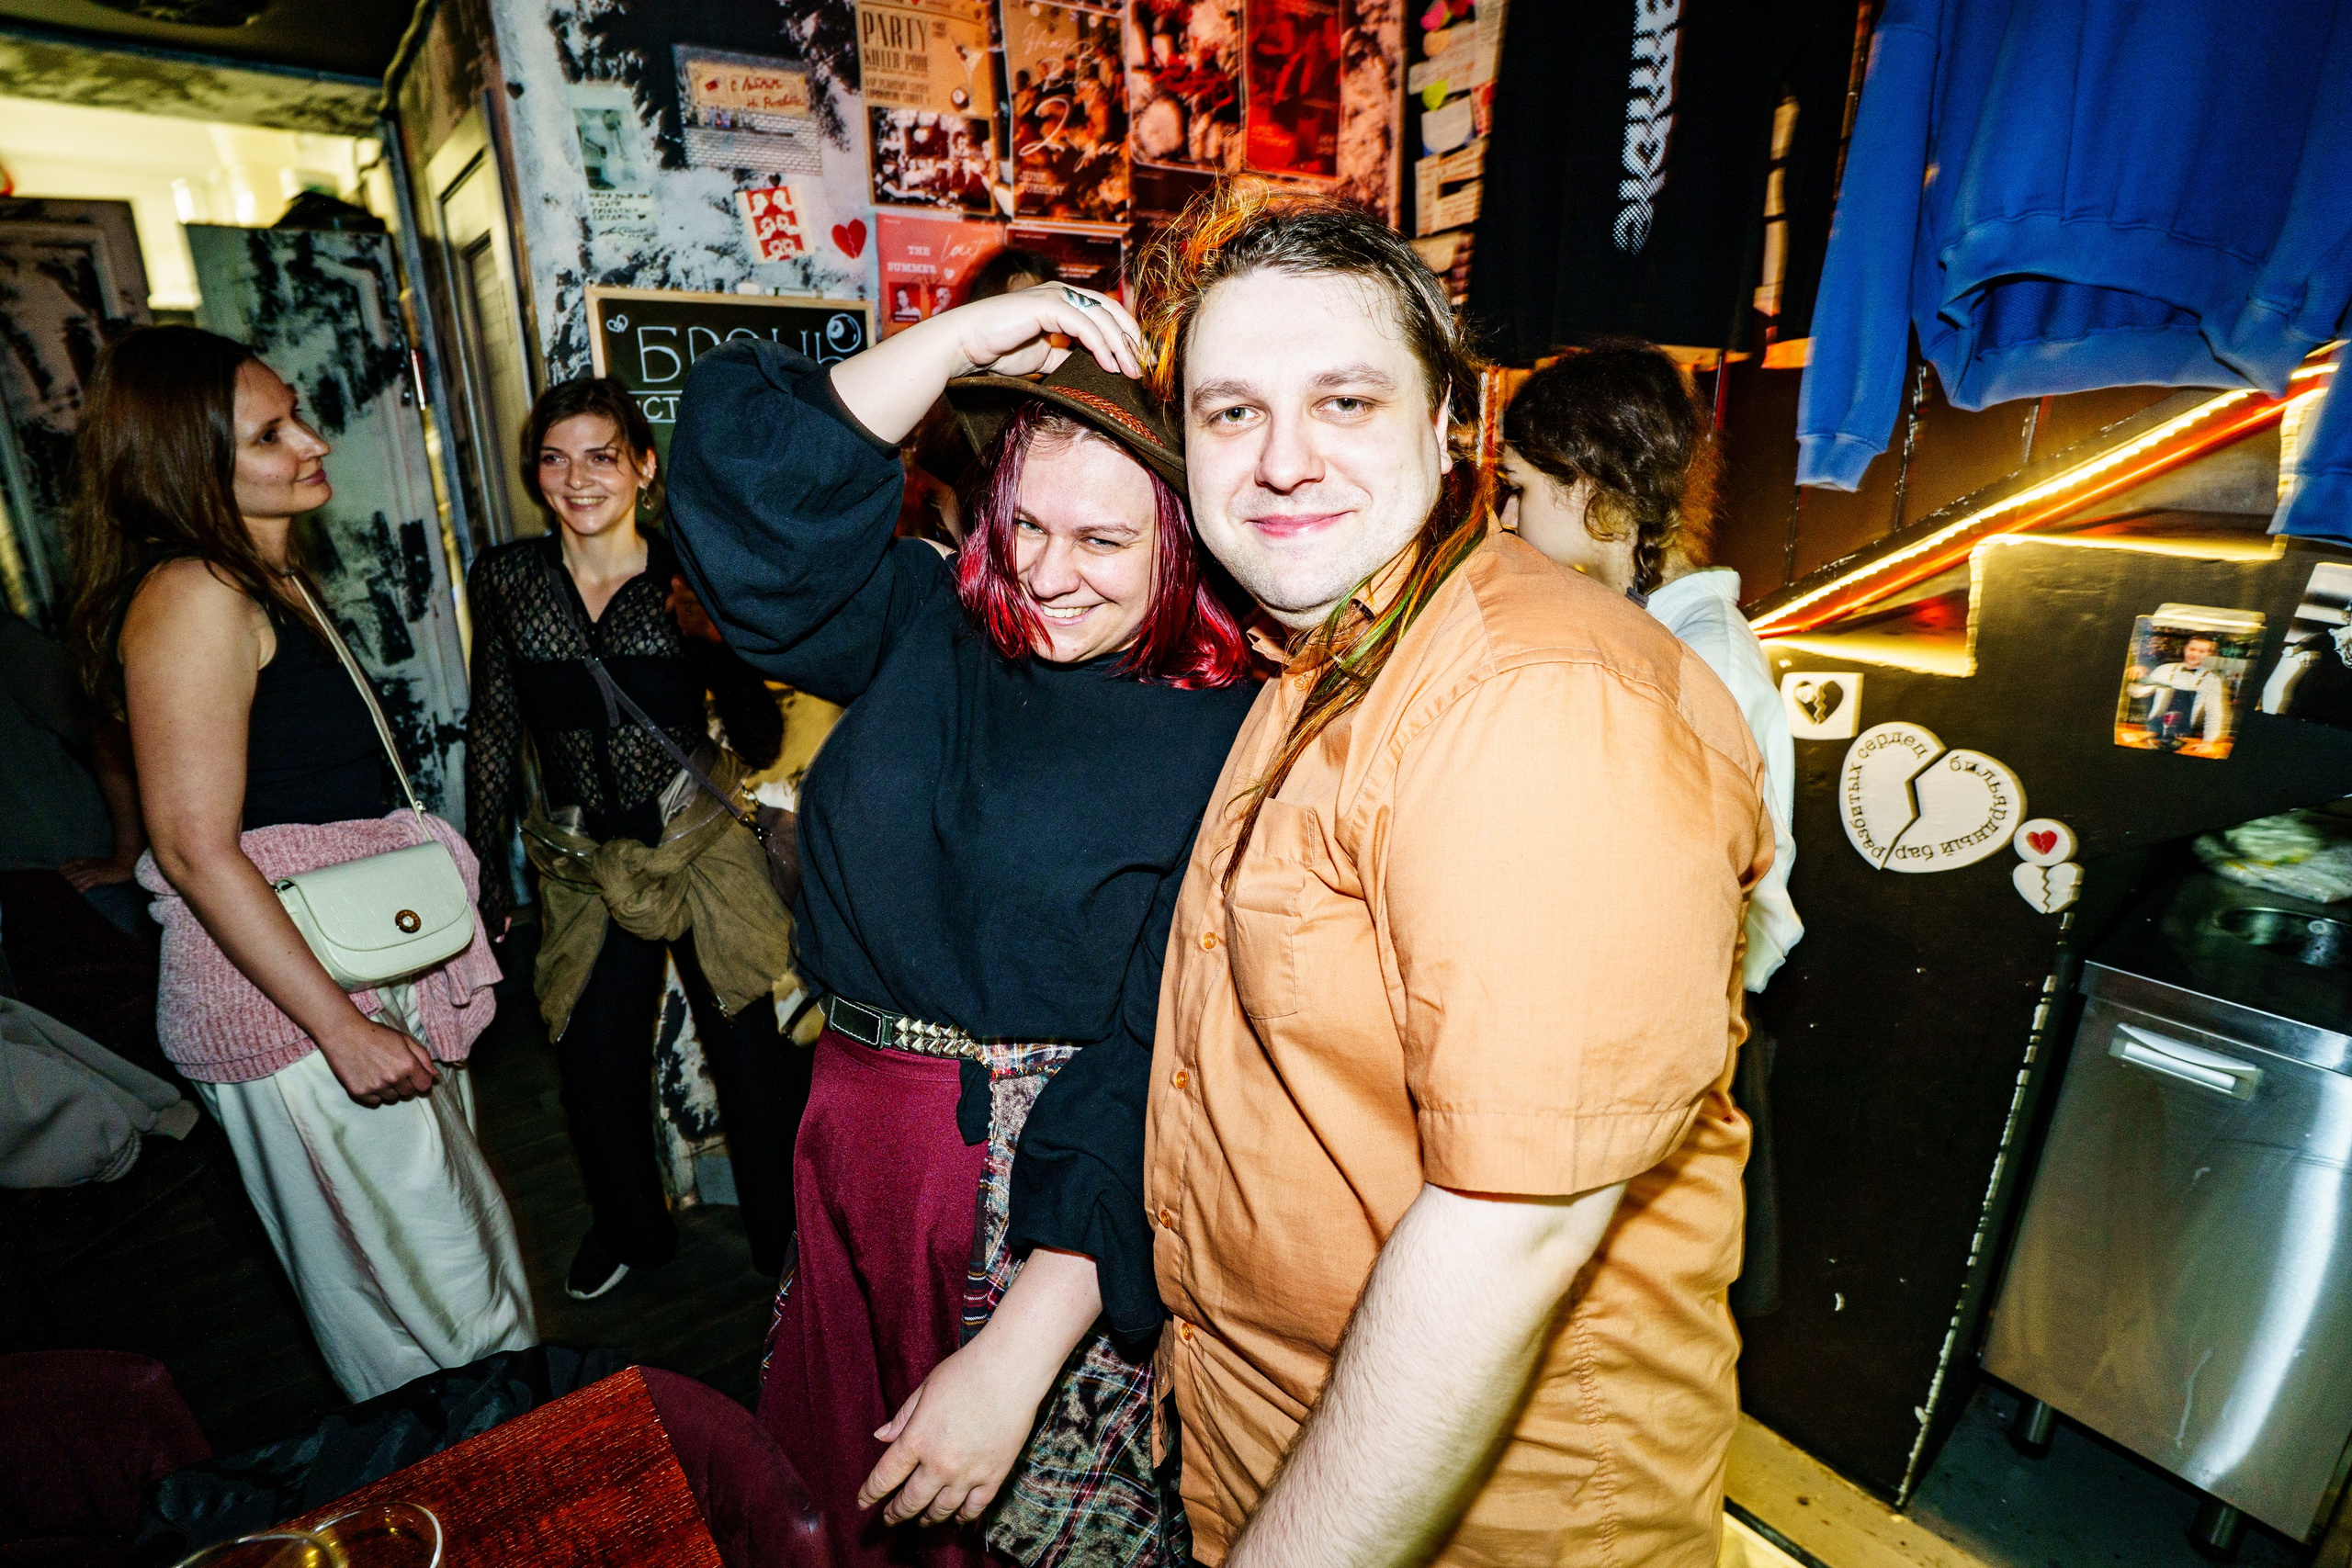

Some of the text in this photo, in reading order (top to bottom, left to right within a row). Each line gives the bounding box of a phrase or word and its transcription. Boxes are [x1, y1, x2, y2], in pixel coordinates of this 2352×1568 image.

[862, 11, 928, 52] PARTY
[887, 262, 937, 275] SUMMER
[907, 244, 931, 256] THE
[1848, 732, 1929, 860] разбитых сердец
[1895, 756, 2007, 862] бильярдный бар
